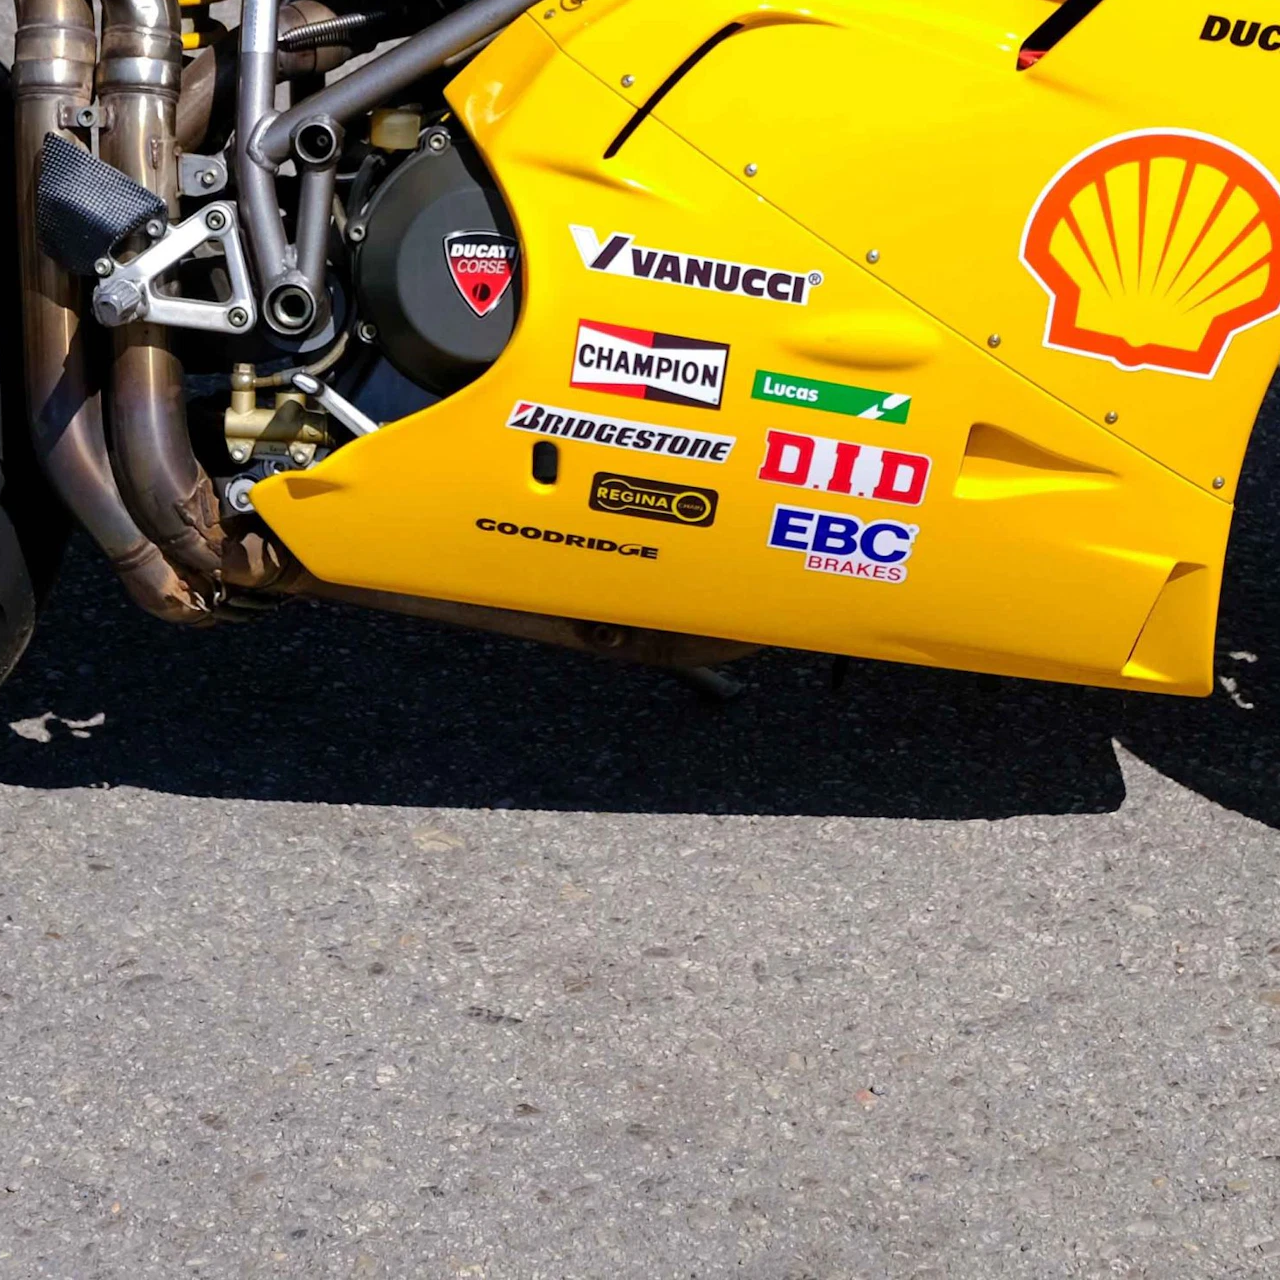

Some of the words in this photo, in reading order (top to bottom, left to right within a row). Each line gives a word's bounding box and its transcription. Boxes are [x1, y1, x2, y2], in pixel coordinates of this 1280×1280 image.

[450, 243, 516, 259] DUCATI
[457, 259, 507, 275] CORSE
[631, 248, 806, 304] VANUCCI
[578, 344, 719, 388] CHAMPION
[763, 376, 819, 402] Lucas
[510, 404, 731, 461] BRIDGESTONE
[759, 430, 929, 505] D.I.D
[597, 487, 669, 509] REGINA
[475, 518, 659, 560] GOODRIDGE
[770, 508, 910, 563] EBC
[807, 555, 902, 582] BRAKES
